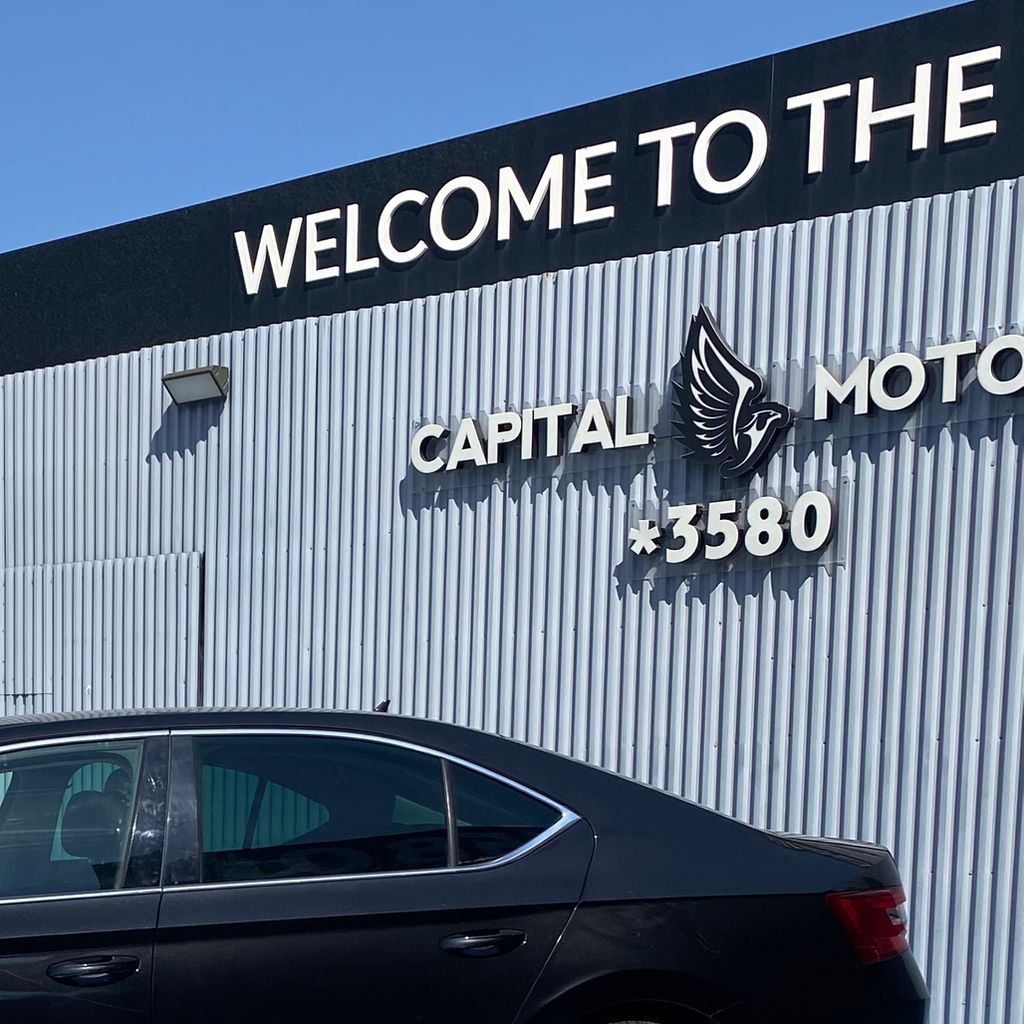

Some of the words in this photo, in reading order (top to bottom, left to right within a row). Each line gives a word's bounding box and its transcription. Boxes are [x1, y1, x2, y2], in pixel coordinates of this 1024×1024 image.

[234, 140, 617, 295] WELCOME
[638, 109, 768, 207] TO
[786, 45, 1002, 174] THE
[412, 393, 650, 474] CAPITAL
[814, 334, 1024, 421] MOTO
